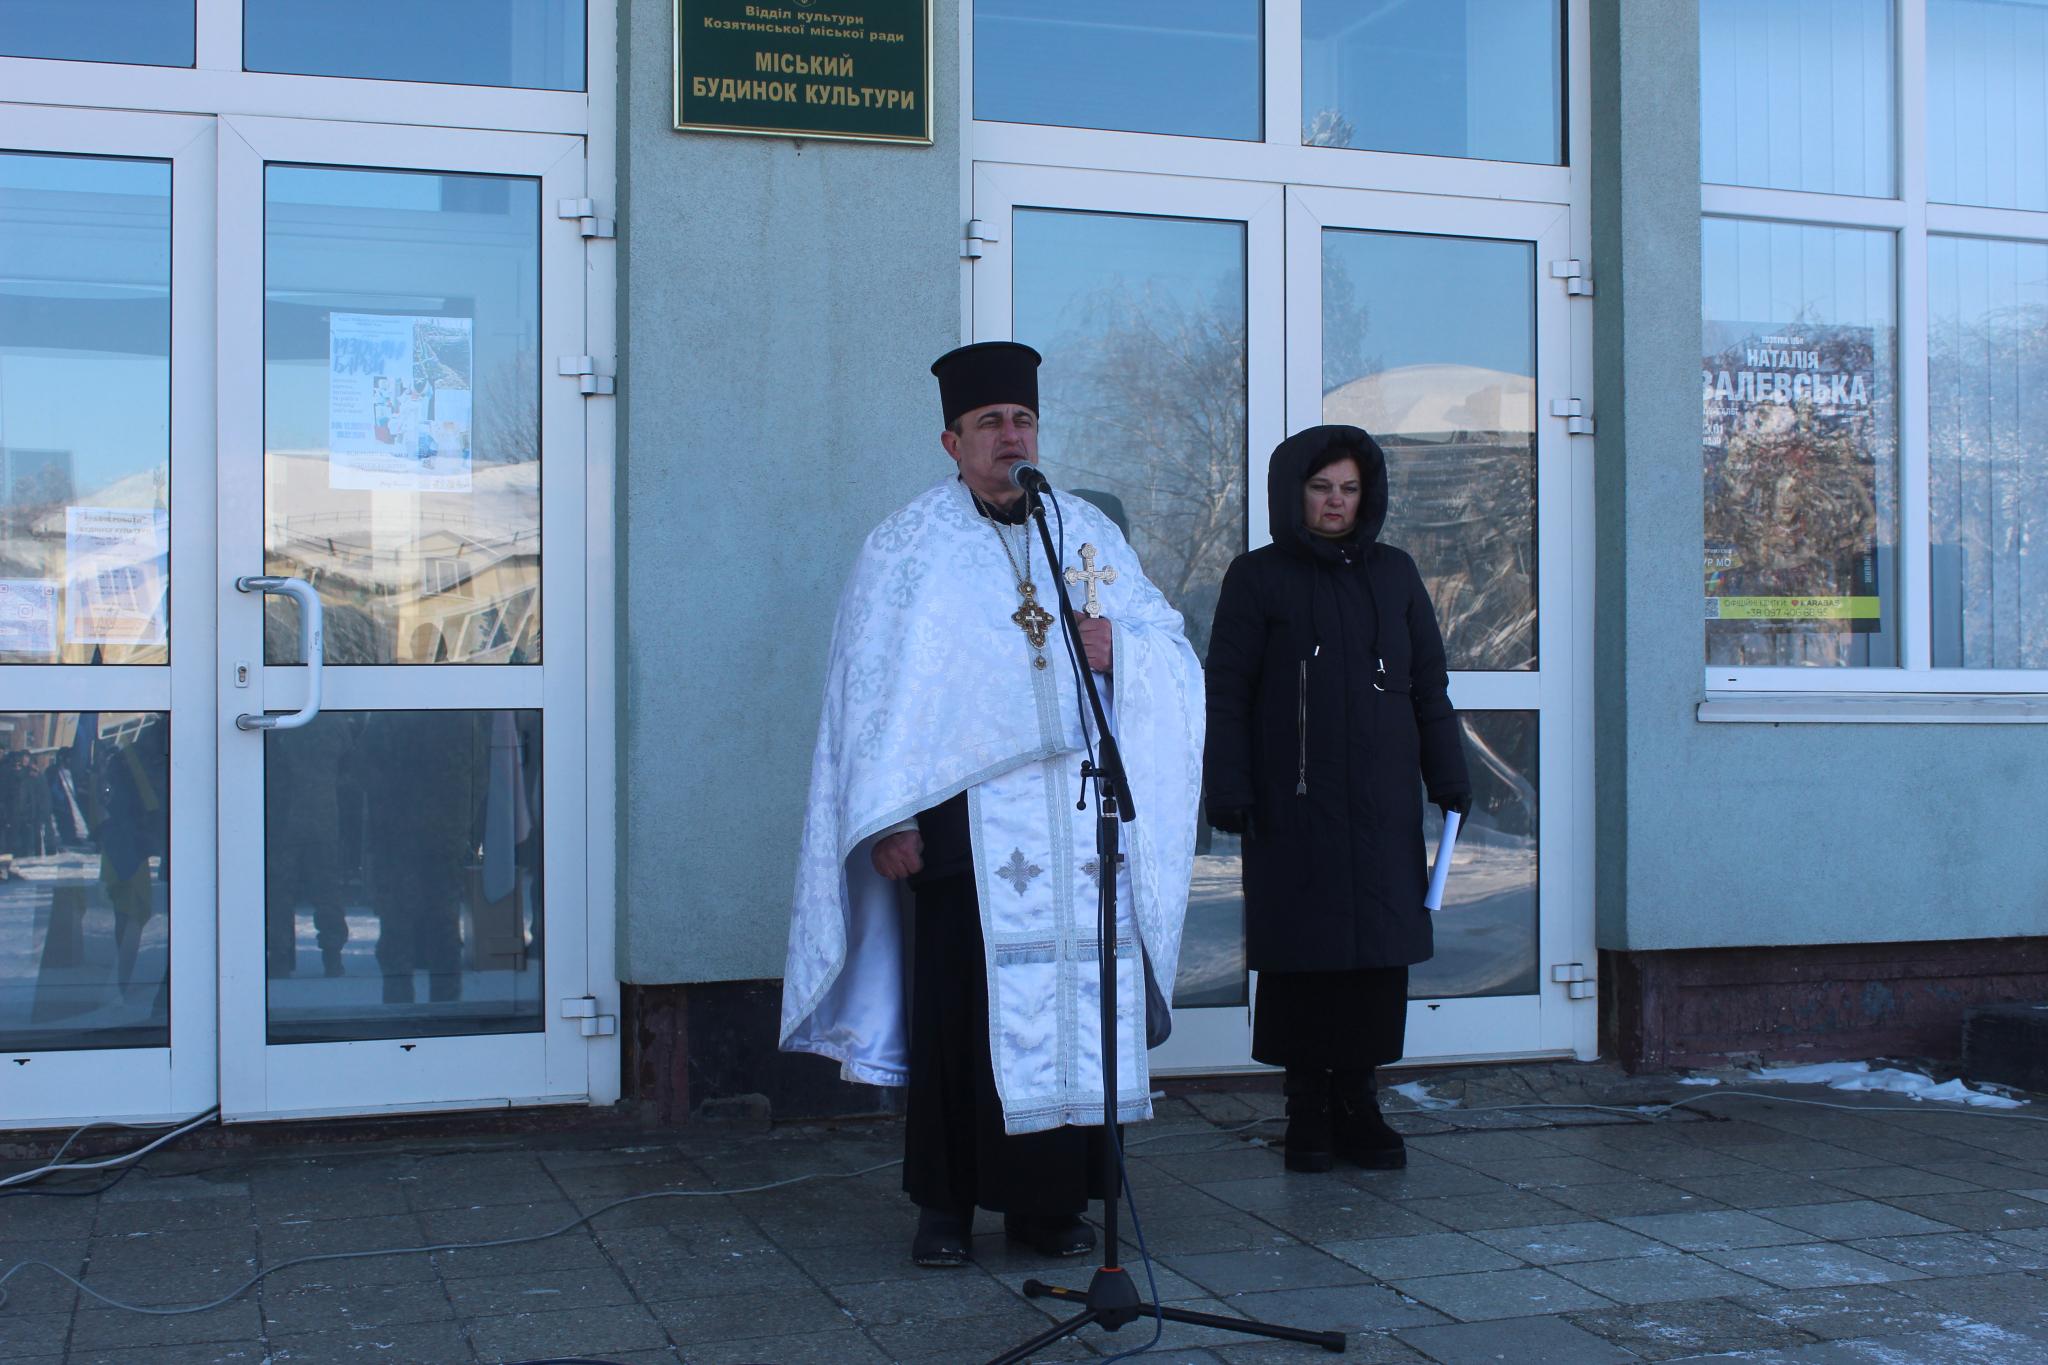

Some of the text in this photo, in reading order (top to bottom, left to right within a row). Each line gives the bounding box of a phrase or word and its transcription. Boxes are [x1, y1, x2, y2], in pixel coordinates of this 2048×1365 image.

[745, 5, 864, 26] Відділ культури
[703, 17, 904, 43] Козятинської міської ради
[755, 51, 854, 78] МІСЬКИЙ
[692, 76, 915, 111] БУДИНОК КУЛЬТУРИ
[1747, 348, 1819, 369] НАТАЛІЯ
